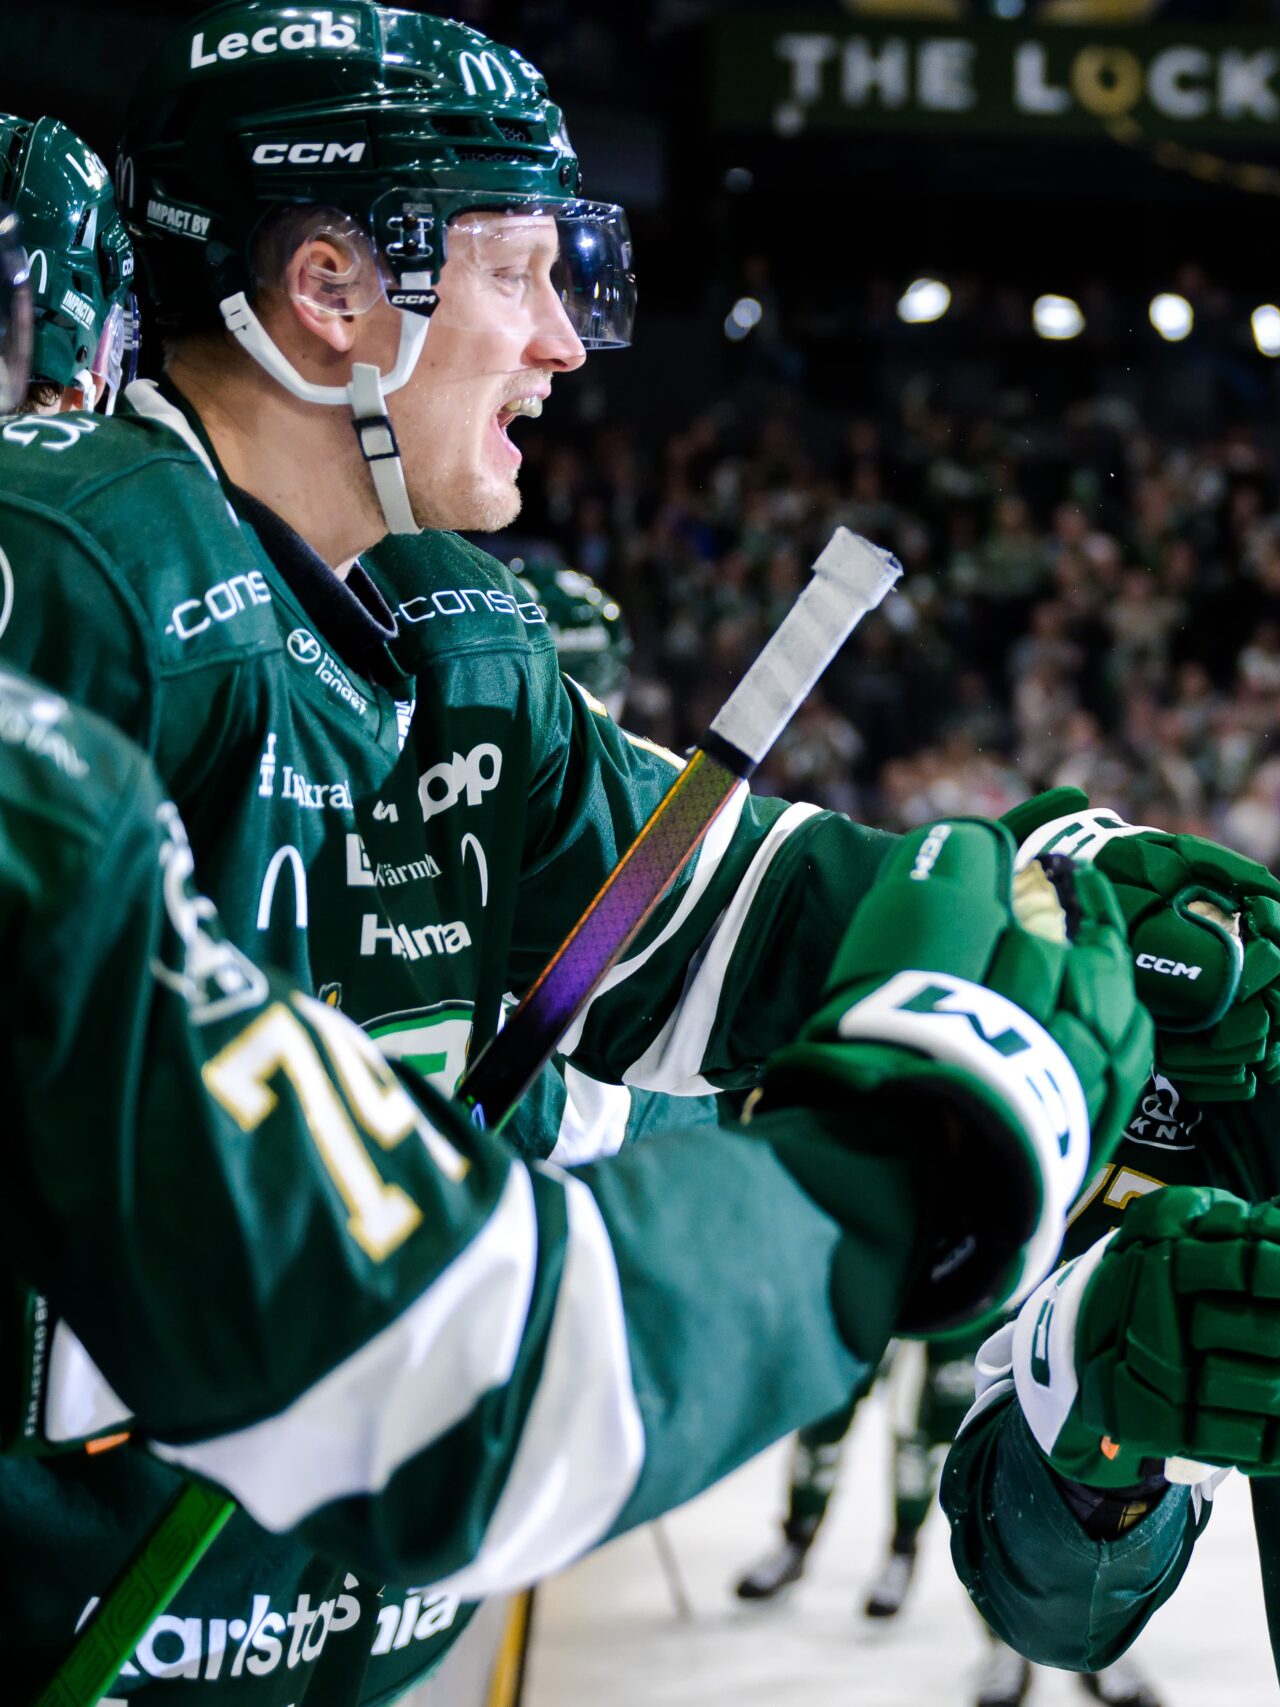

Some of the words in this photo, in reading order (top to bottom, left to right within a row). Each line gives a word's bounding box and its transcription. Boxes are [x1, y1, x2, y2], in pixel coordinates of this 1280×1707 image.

[190, 12, 356, 69] Lecab
[774, 33, 977, 112] THE
[252, 142, 366, 164] CCM
[147, 199, 191, 230] IMPACT
[191, 214, 212, 236] BY
[391, 294, 437, 305] CCM
[1136, 952, 1203, 980] CCM
[201, 990, 473, 1265] 74
